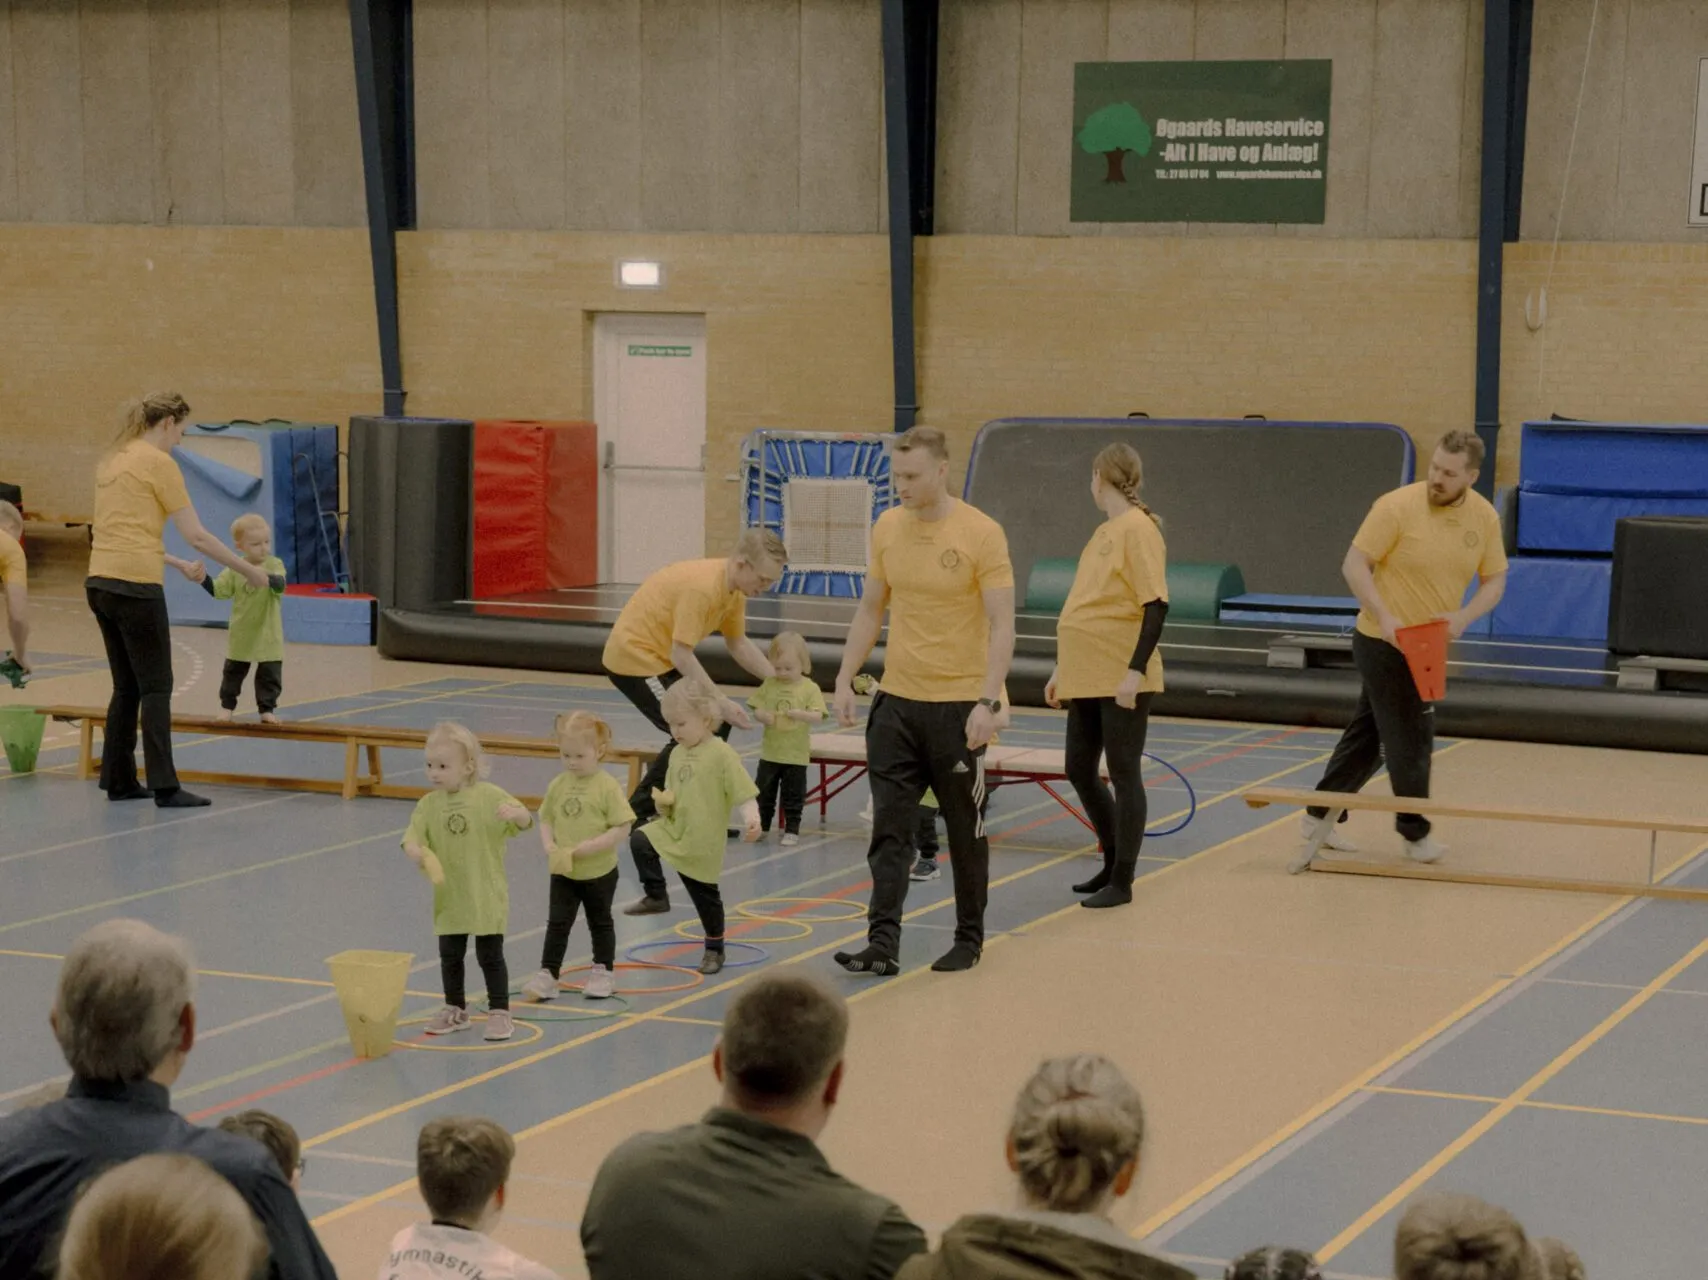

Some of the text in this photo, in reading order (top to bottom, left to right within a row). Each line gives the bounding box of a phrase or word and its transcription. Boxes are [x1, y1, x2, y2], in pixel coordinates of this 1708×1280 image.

[1225, 118, 1324, 137] Haveservice
[1198, 143, 1237, 161] Have
[1239, 146, 1260, 163] og
[1262, 143, 1319, 164] Anlæg!
